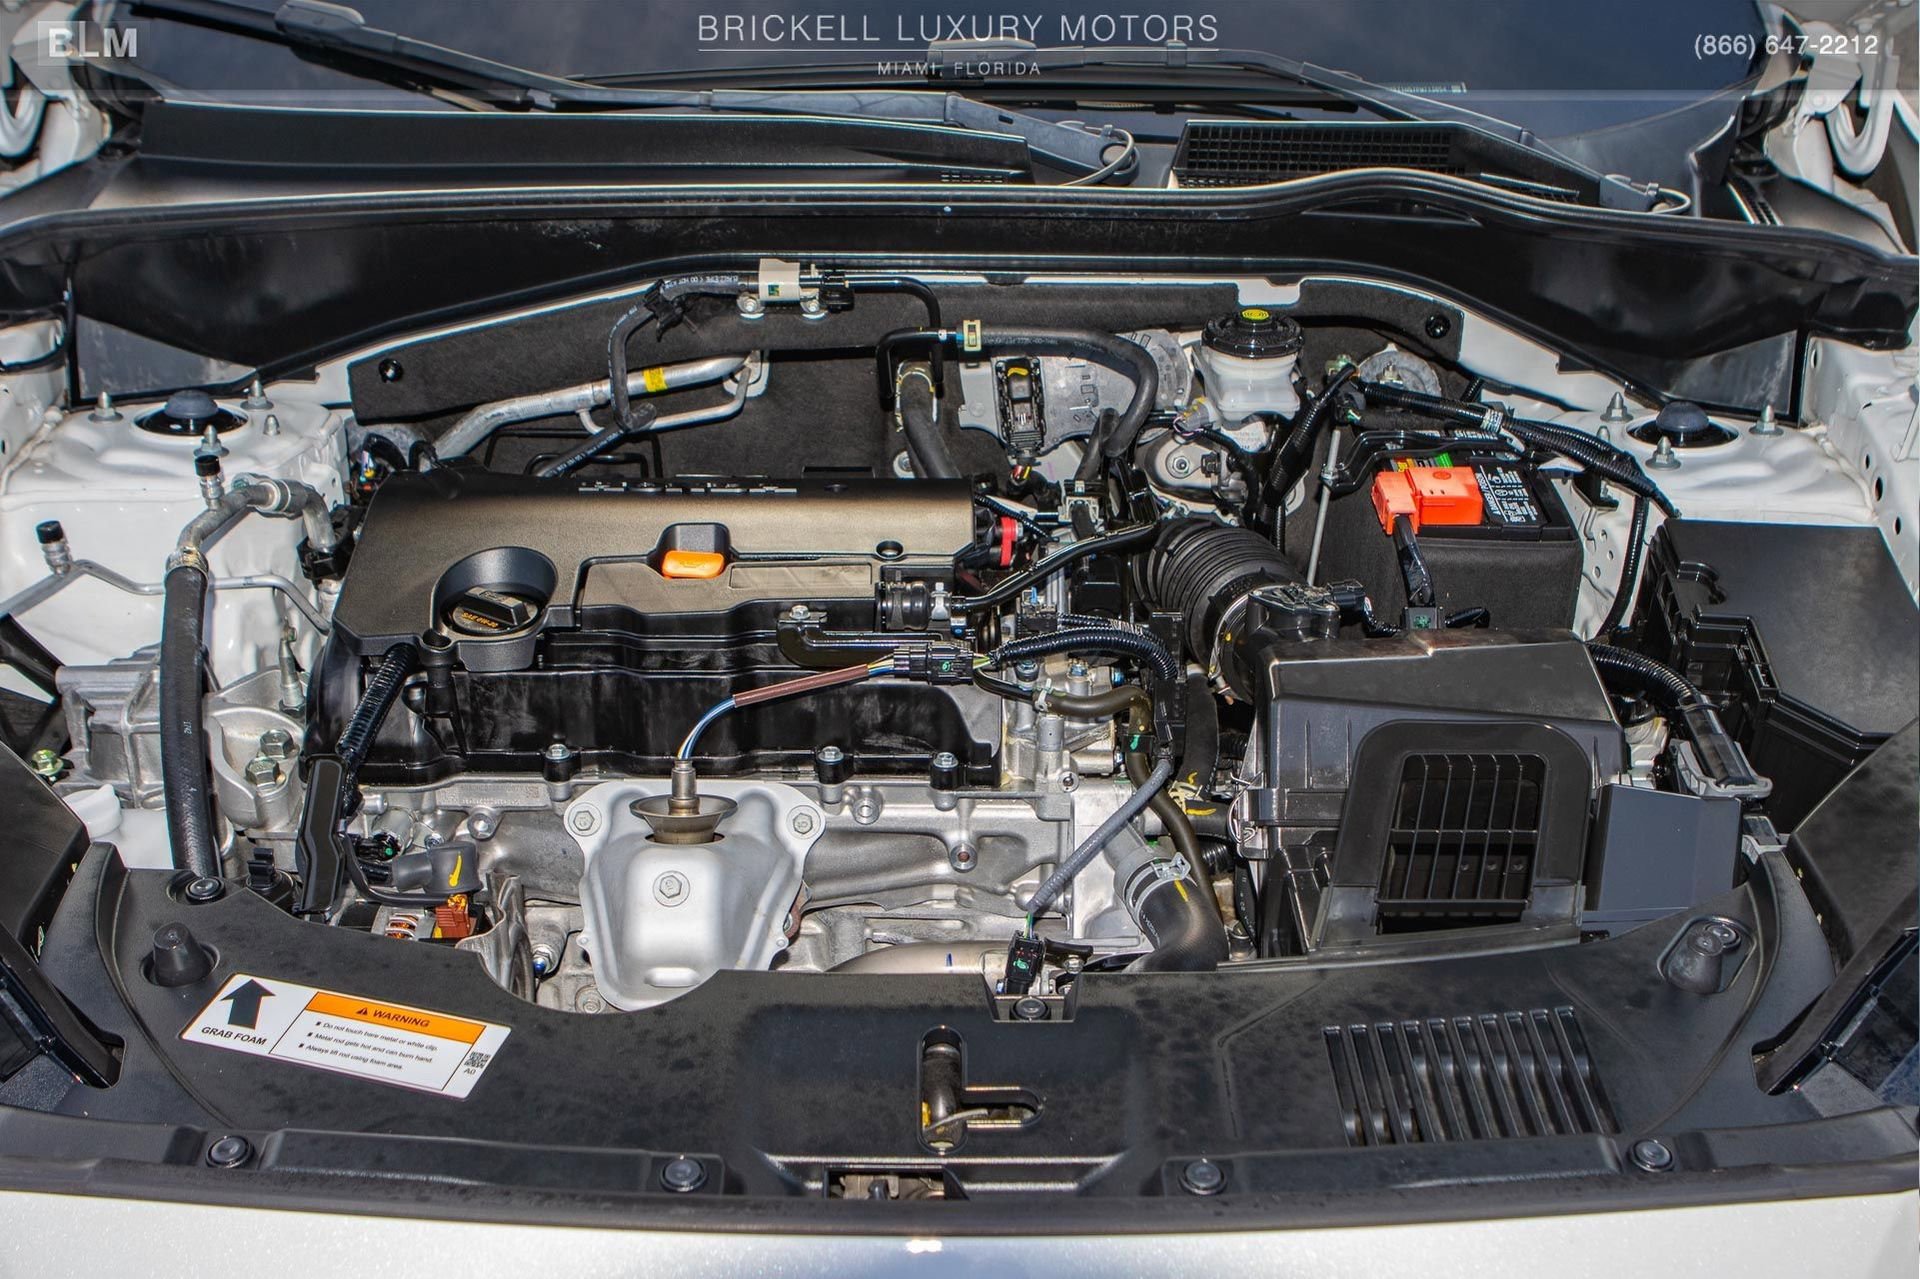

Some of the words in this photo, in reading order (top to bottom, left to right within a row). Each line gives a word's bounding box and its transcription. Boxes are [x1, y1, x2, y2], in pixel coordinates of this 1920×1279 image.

[372, 1009, 430, 1028] WARNING
[201, 1026, 233, 1039] GRAB
[233, 1032, 268, 1046] FOAM
[314, 1032, 334, 1041] Metal
[344, 1039, 360, 1048] gets
[360, 1042, 372, 1050] hot
[372, 1045, 385, 1053] and
[398, 1051, 414, 1060] burn
[345, 1027, 363, 1036] touch
[379, 1034, 399, 1043] metal
[406, 1039, 425, 1048] white
[306, 1044, 329, 1054] Always
[350, 1054, 369, 1063] using
[370, 1058, 386, 1067] foam
